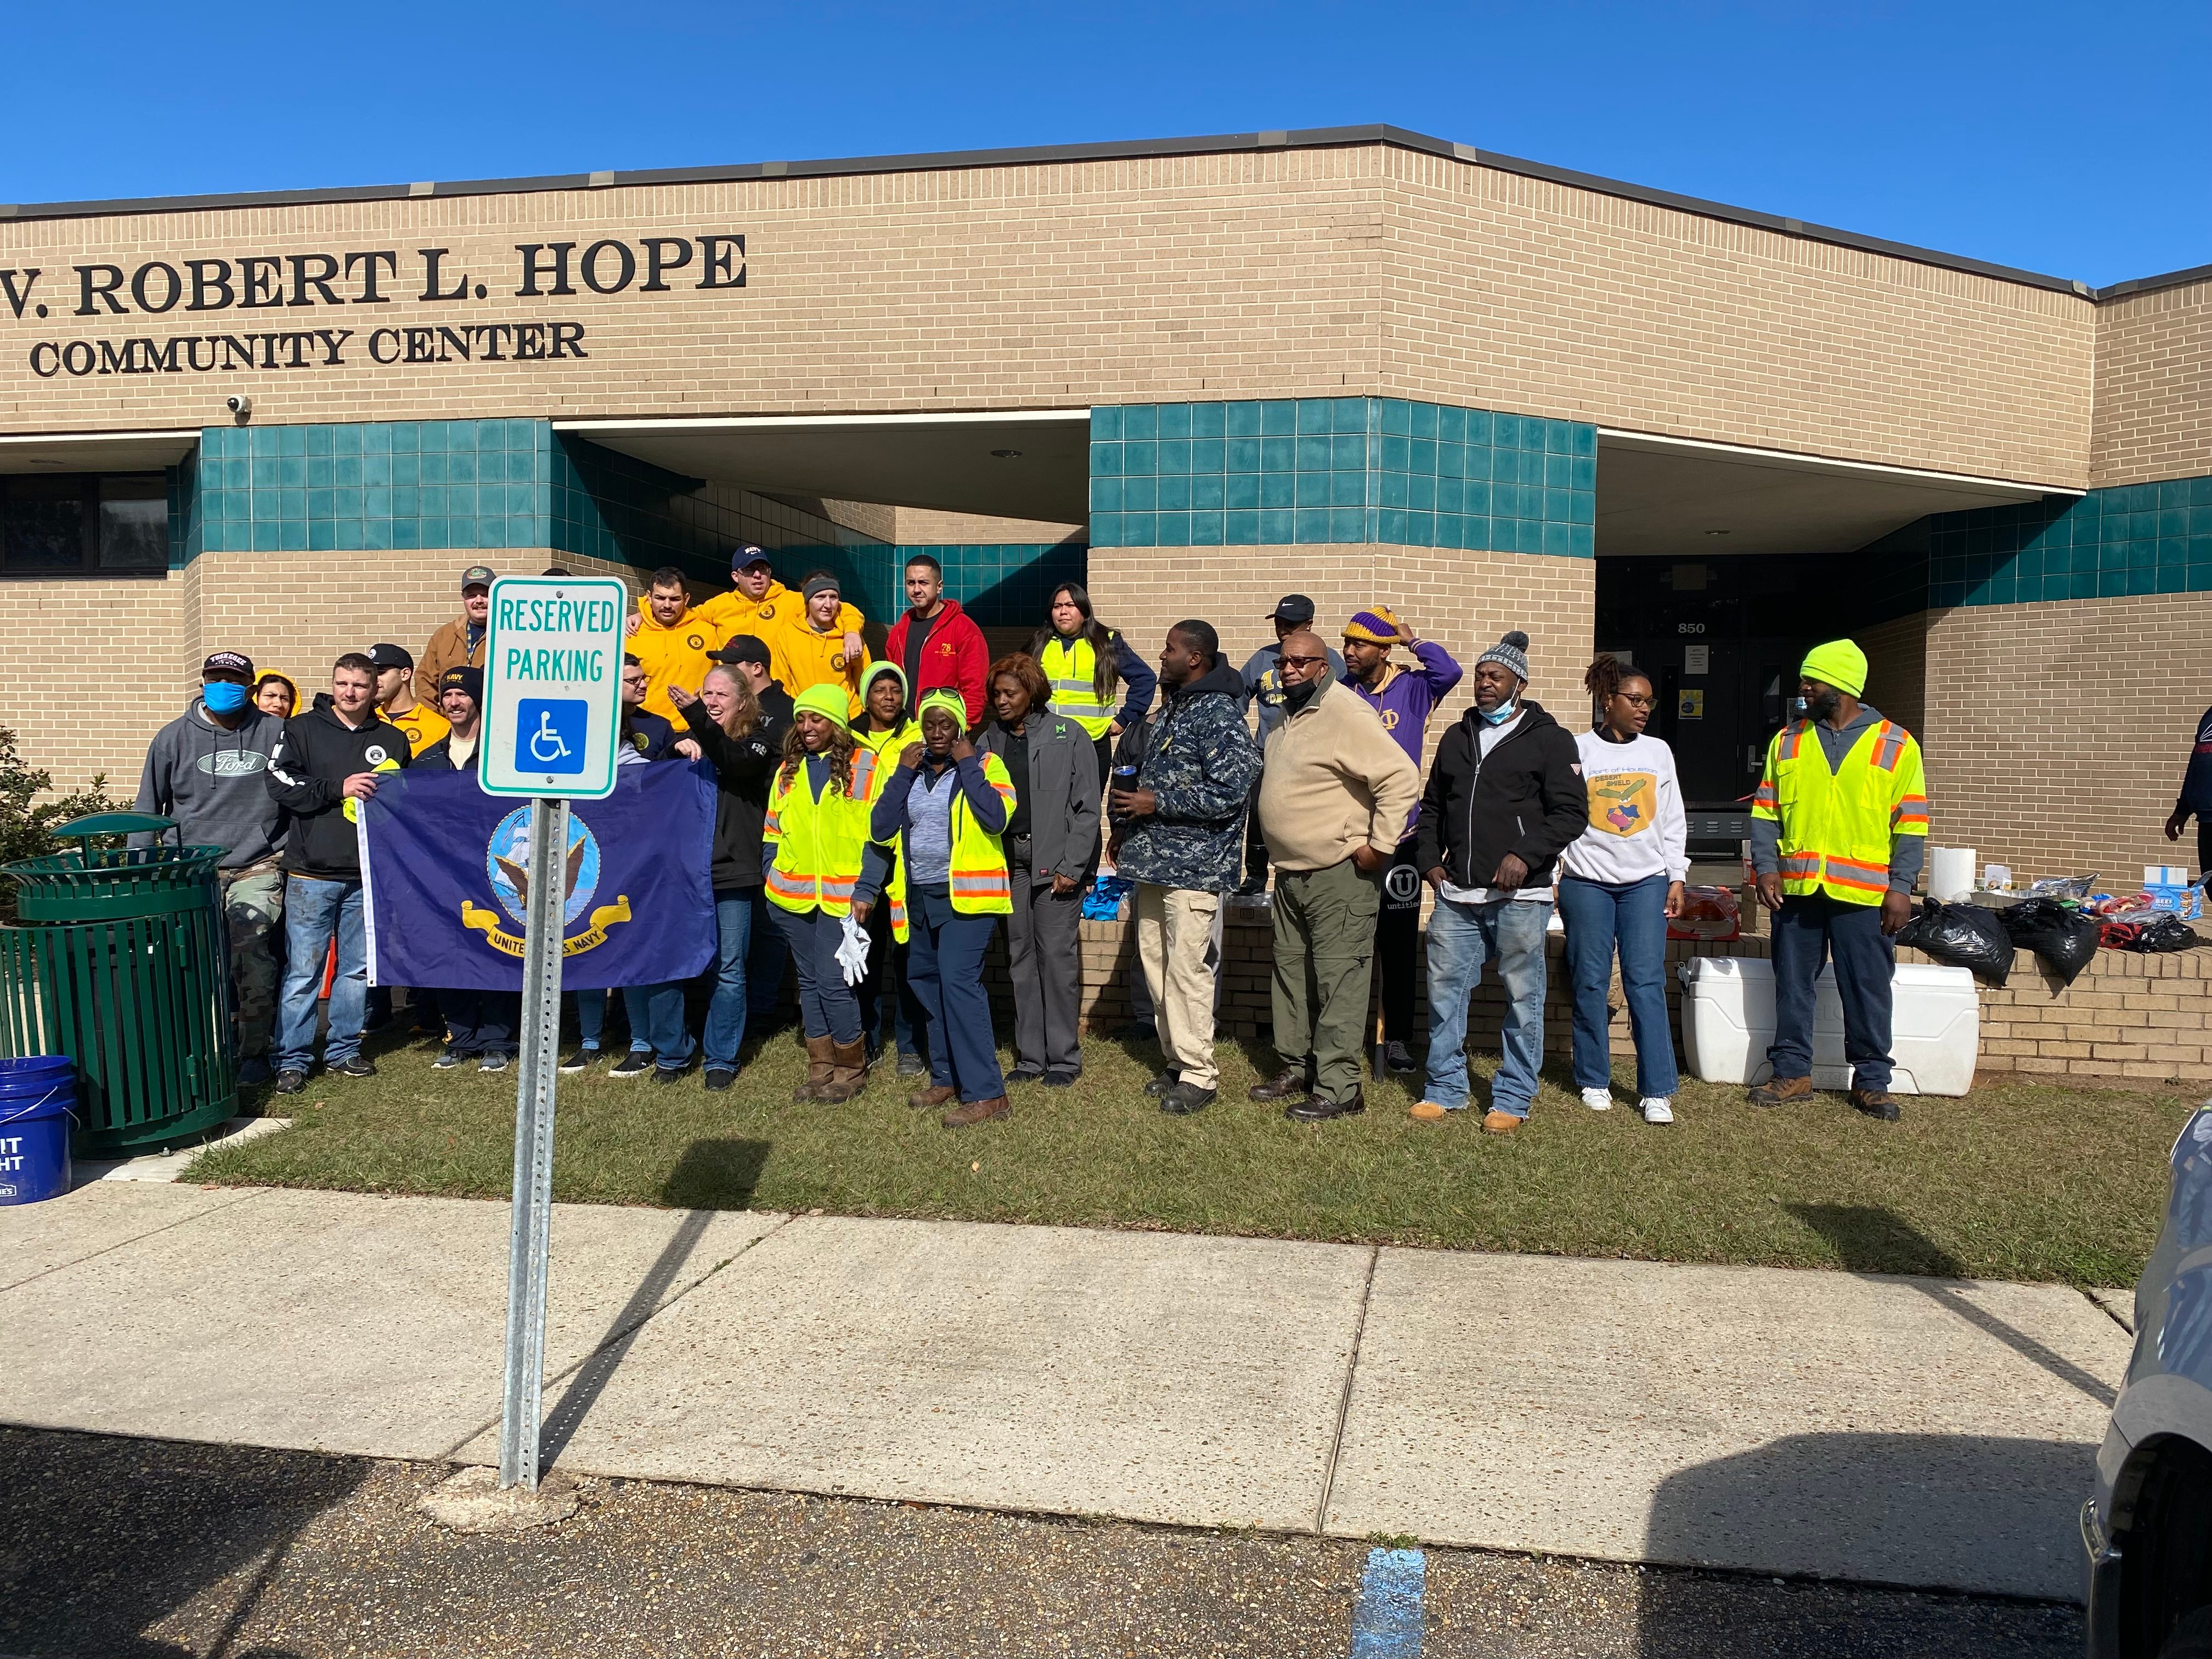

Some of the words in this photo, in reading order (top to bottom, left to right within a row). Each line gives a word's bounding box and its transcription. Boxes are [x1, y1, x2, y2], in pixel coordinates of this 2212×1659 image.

[74, 250, 397, 315] ROBERT
[417, 247, 488, 302] L.
[515, 234, 747, 297] HOPE
[29, 329, 354, 377] COMMUNITY
[368, 321, 589, 365] CENTER
[500, 599, 614, 632] RESERVED
[1678, 623, 1705, 633] 850
[942, 643, 951, 652] 78
[210, 653, 247, 665] TUSKEGEE
[506, 648, 602, 682] PARKING
[215, 753, 258, 772] Ford
[1206, 747, 1218, 759] LEWIS
[1394, 873, 1413, 895] U
[1387, 900, 1420, 909] untitled
[494, 933, 524, 955] UNITE
[573, 930, 601, 950] NAVY
